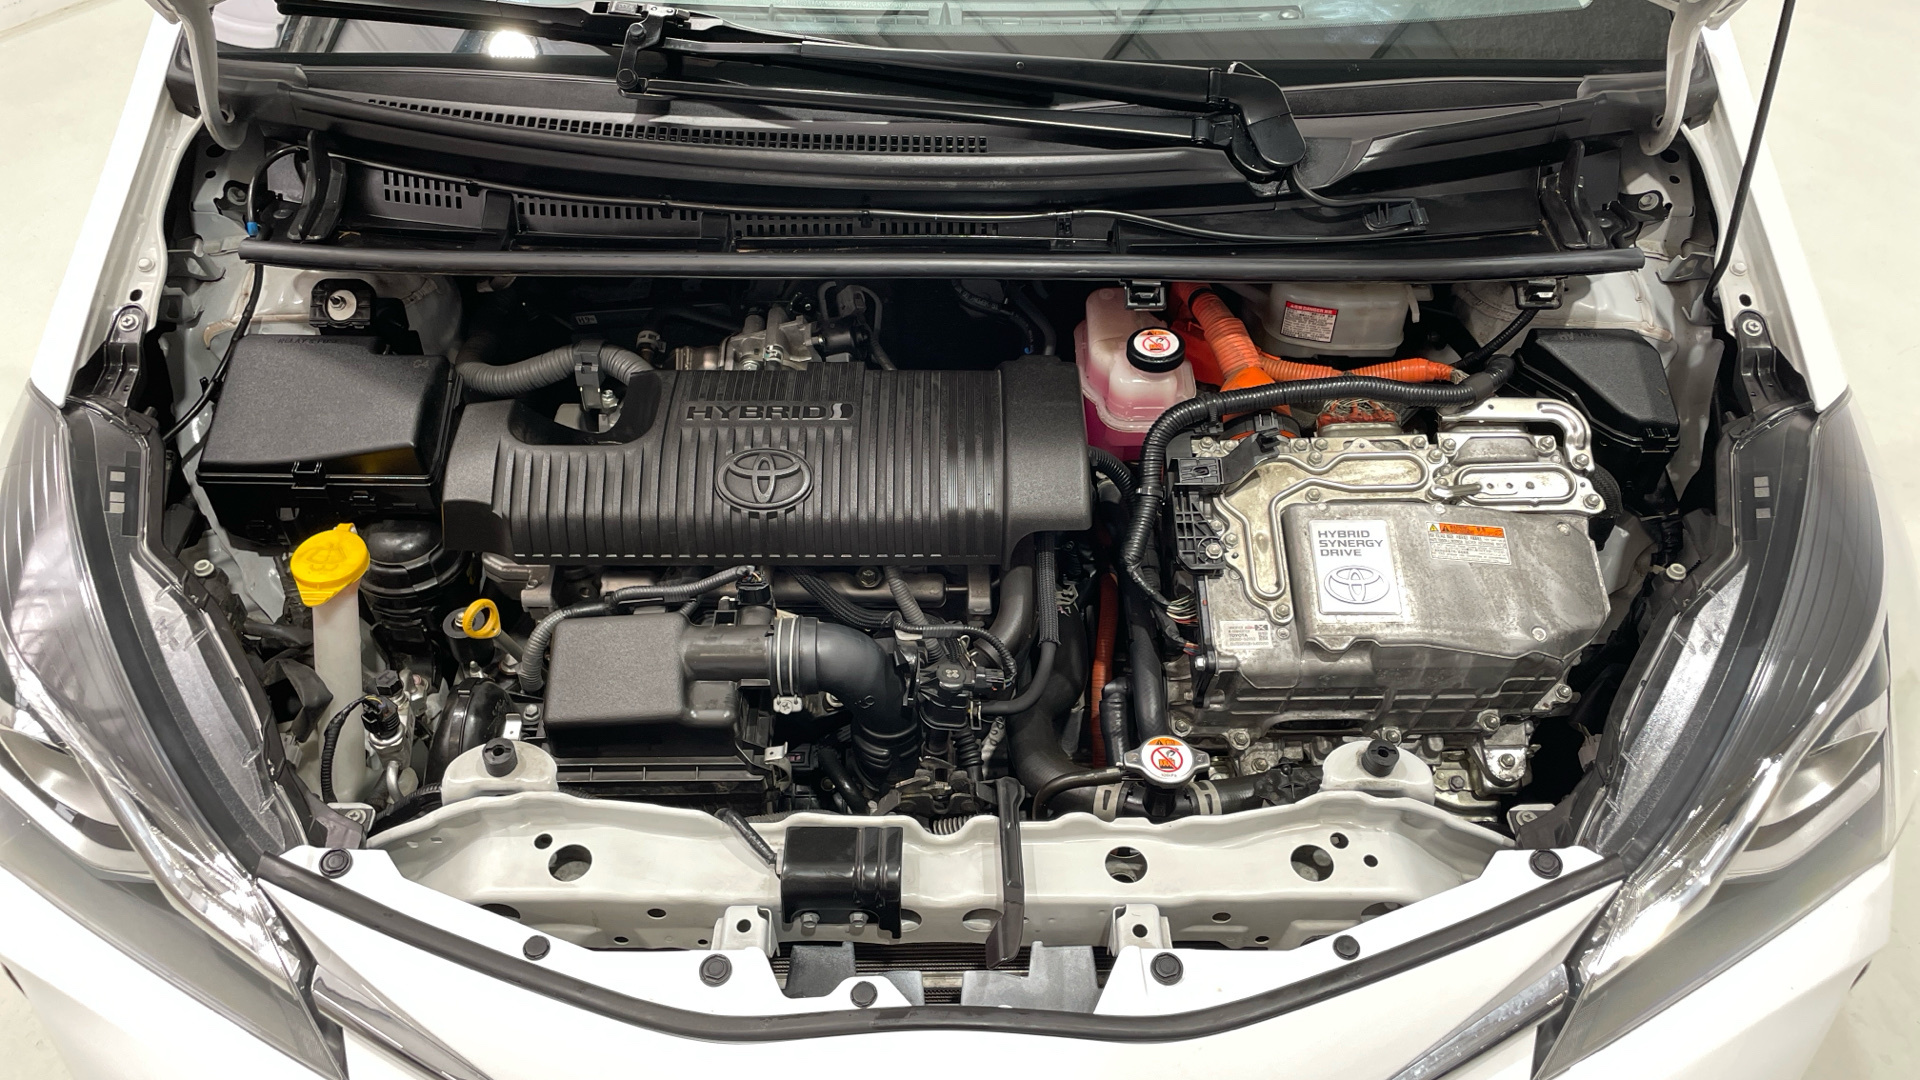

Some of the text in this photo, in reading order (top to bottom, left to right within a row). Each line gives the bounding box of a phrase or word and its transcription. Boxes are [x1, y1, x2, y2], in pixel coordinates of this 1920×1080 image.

[686, 405, 827, 421] HYBRID
[1318, 530, 1370, 538] HYBRID
[1319, 539, 1383, 548] SYNERGY
[1320, 549, 1362, 557] DRIVE
